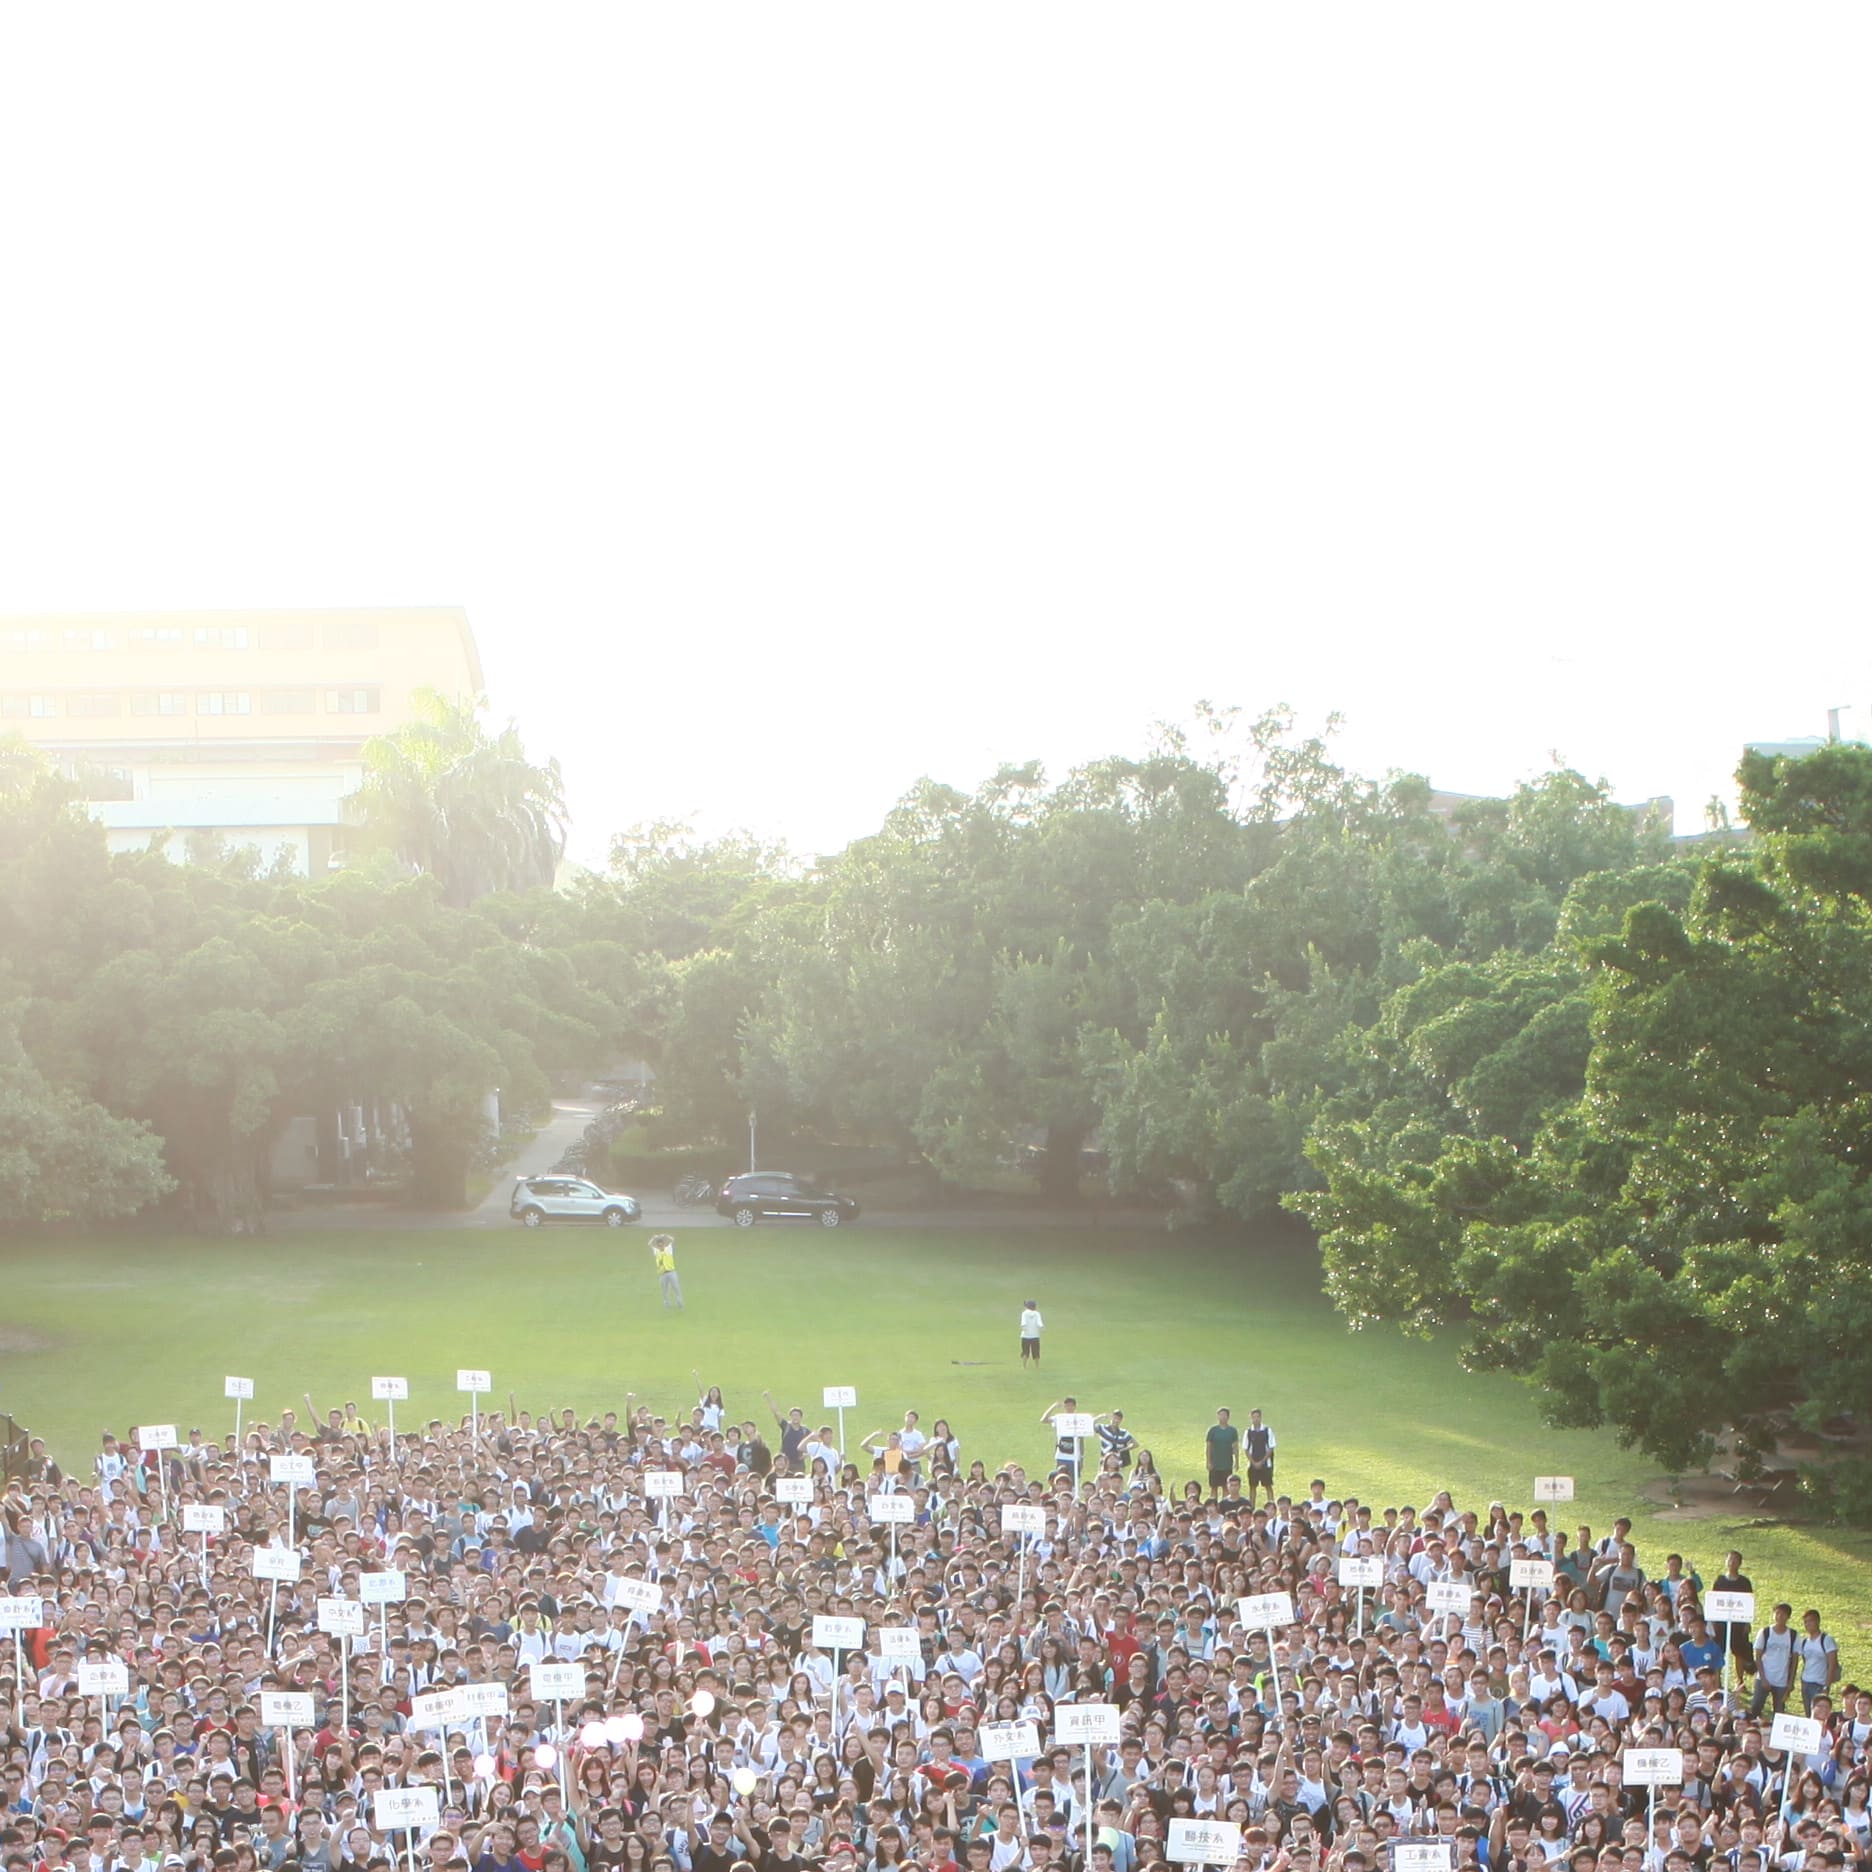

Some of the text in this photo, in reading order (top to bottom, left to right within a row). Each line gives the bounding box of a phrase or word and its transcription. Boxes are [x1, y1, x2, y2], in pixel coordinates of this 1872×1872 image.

[1069, 1714, 1106, 1727] 資訊甲
[389, 1798, 424, 1811] 化學系
